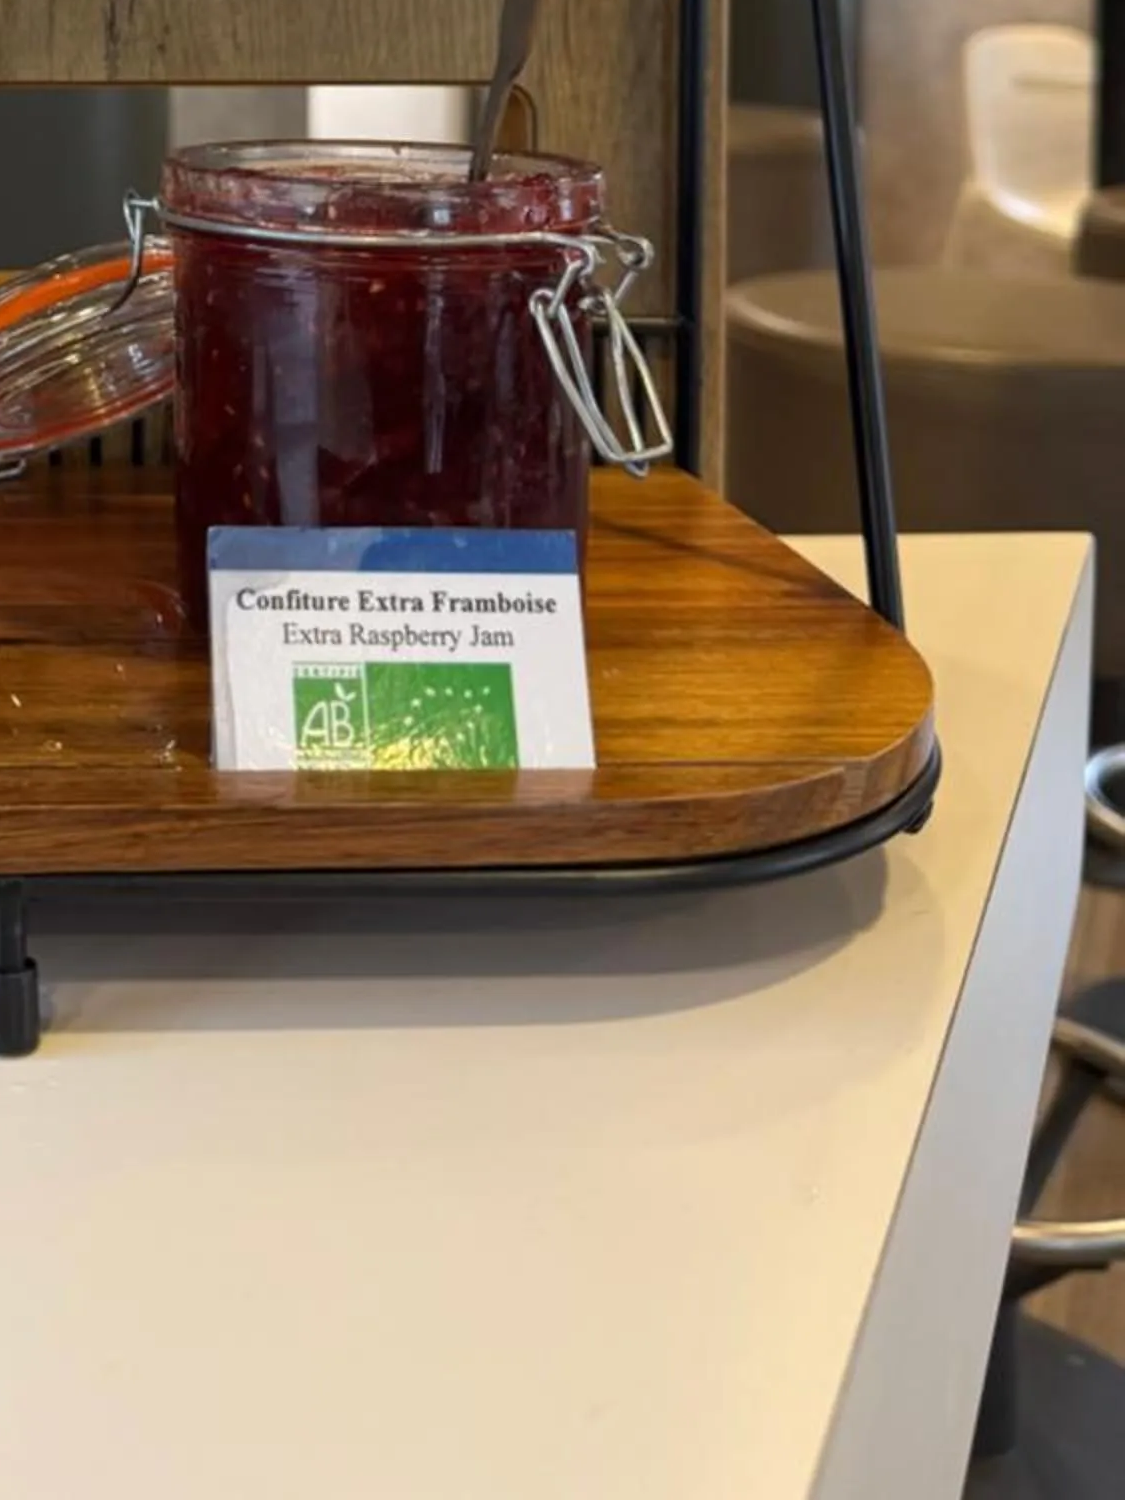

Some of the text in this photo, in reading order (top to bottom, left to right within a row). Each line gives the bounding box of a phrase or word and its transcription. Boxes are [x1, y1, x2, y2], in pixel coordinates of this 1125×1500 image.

[236, 587, 558, 614] Confiture Extra Framboise
[282, 622, 515, 652] Extra Raspberry Jam
[300, 700, 356, 748] AB
